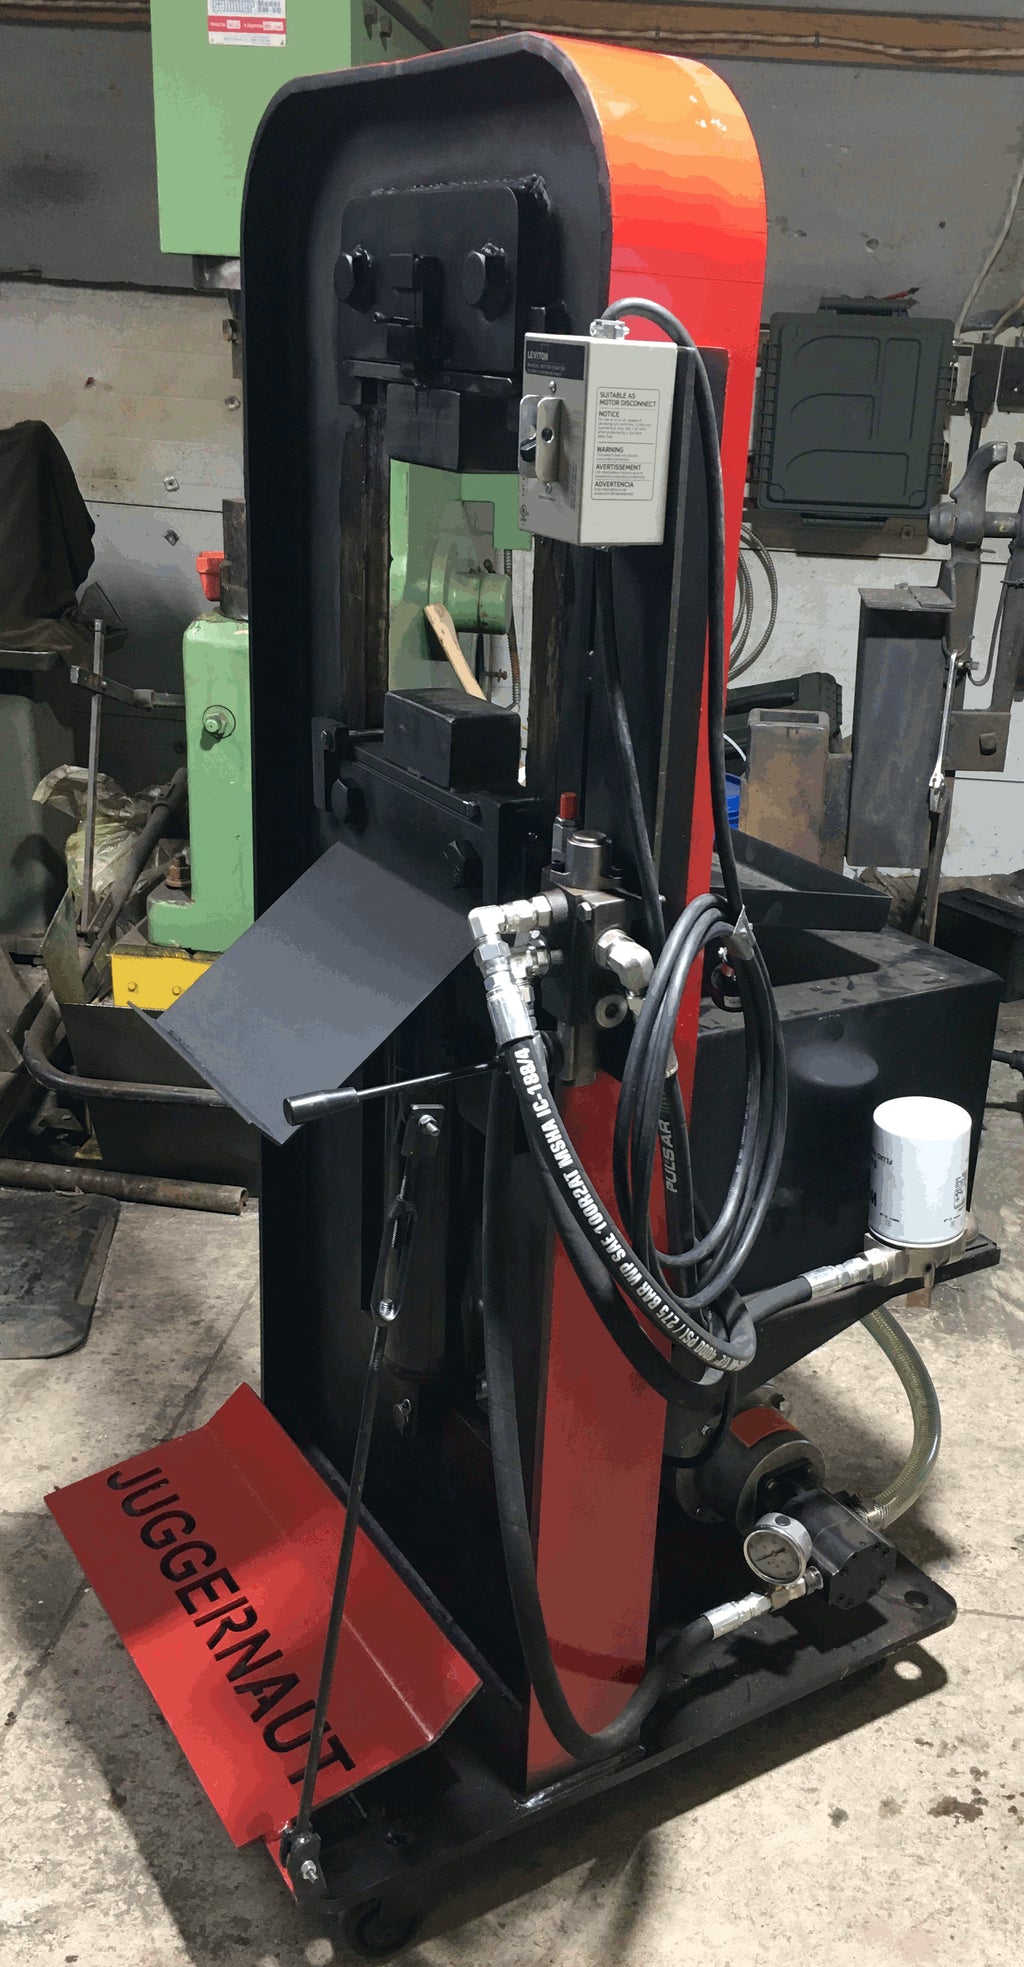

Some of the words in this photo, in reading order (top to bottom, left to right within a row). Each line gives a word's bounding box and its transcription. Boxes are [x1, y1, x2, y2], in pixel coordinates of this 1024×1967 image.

[527, 350, 549, 361] LEVITON
[599, 391, 627, 399] SUITABLE
[620, 400, 657, 408] DISCONNECT
[598, 410, 620, 418] NOTICE
[595, 463, 642, 471] AVERTISSEMENT
[594, 480, 634, 488] ADVERTENCIA
[514, 1047, 552, 1118] IC-188/4
[541, 1118, 574, 1169] MSHA
[658, 1119, 678, 1193] PULSAR
[562, 1169, 608, 1235] 100R2AT
[600, 1232, 626, 1263] SAE
[619, 1261, 643, 1286] WP
[636, 1280, 662, 1310] BAR
[655, 1304, 680, 1329] 275
[671, 1323, 686, 1333] /
[678, 1327, 700, 1348] PSI
[693, 1340, 717, 1361] 4000
[106, 1465, 356, 1786] JUGGERNAUT
